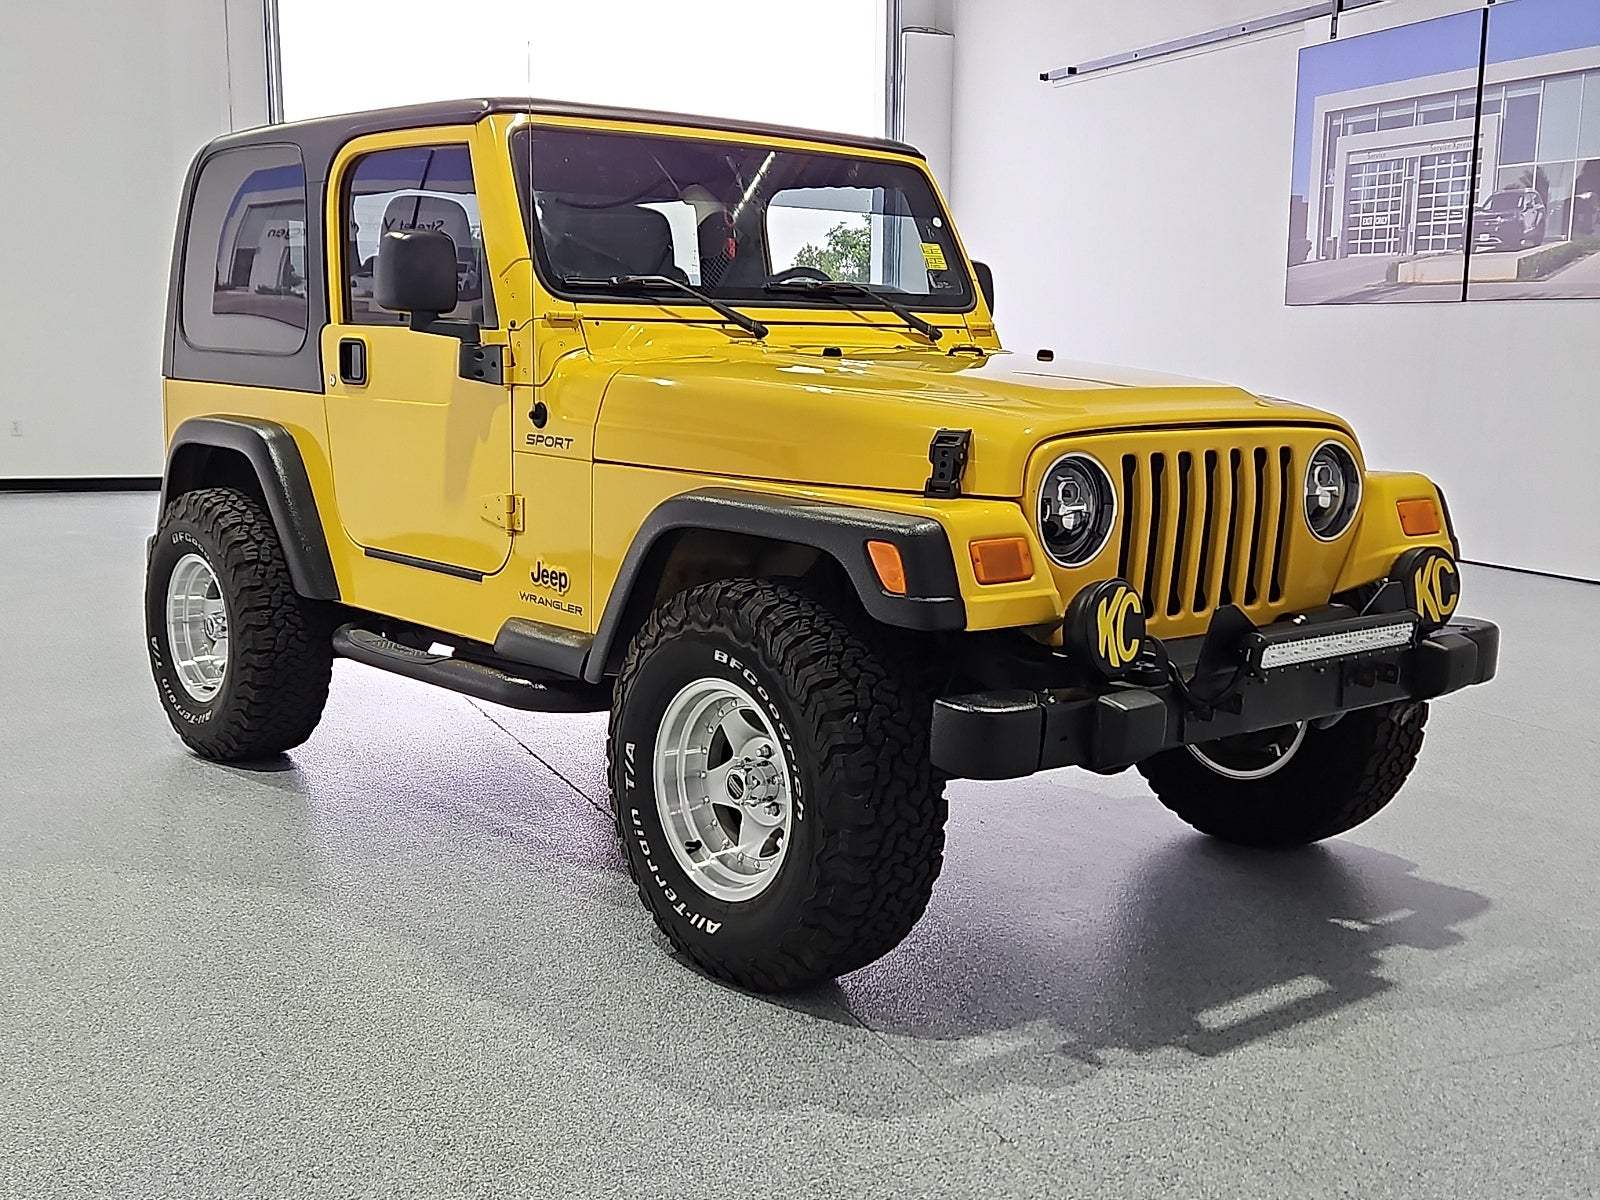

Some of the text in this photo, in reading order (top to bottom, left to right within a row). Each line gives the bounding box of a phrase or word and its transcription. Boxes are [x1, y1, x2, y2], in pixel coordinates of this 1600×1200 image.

[526, 434, 574, 449] SPORT
[530, 561, 568, 592] Jeep
[1414, 554, 1458, 623] KC
[519, 591, 583, 616] WRANGLER
[1096, 586, 1141, 668] KC
[625, 742, 722, 936] All-Terrain T/A
